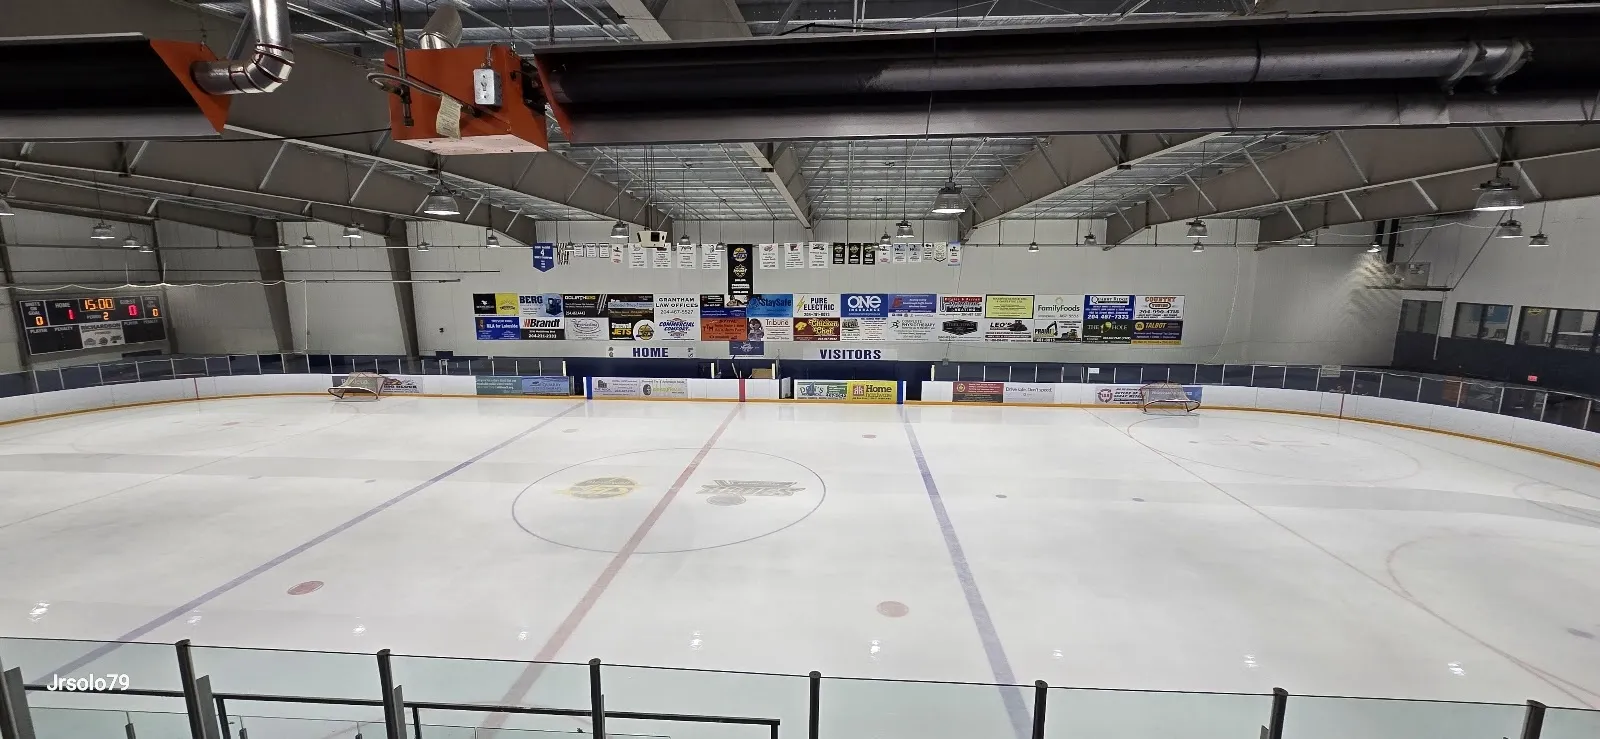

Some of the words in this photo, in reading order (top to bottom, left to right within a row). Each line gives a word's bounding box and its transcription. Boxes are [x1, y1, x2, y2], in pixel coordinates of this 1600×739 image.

[84, 298, 114, 310] 15:00
[760, 299, 792, 307] StaySafe
[68, 310, 74, 319] 1
[128, 305, 137, 316] 0
[153, 309, 159, 317] 0
[103, 312, 109, 320] 2
[36, 316, 43, 326] 0
[530, 319, 560, 327] Brandt
[633, 348, 668, 358] HOME
[820, 349, 881, 360] VISITORS
